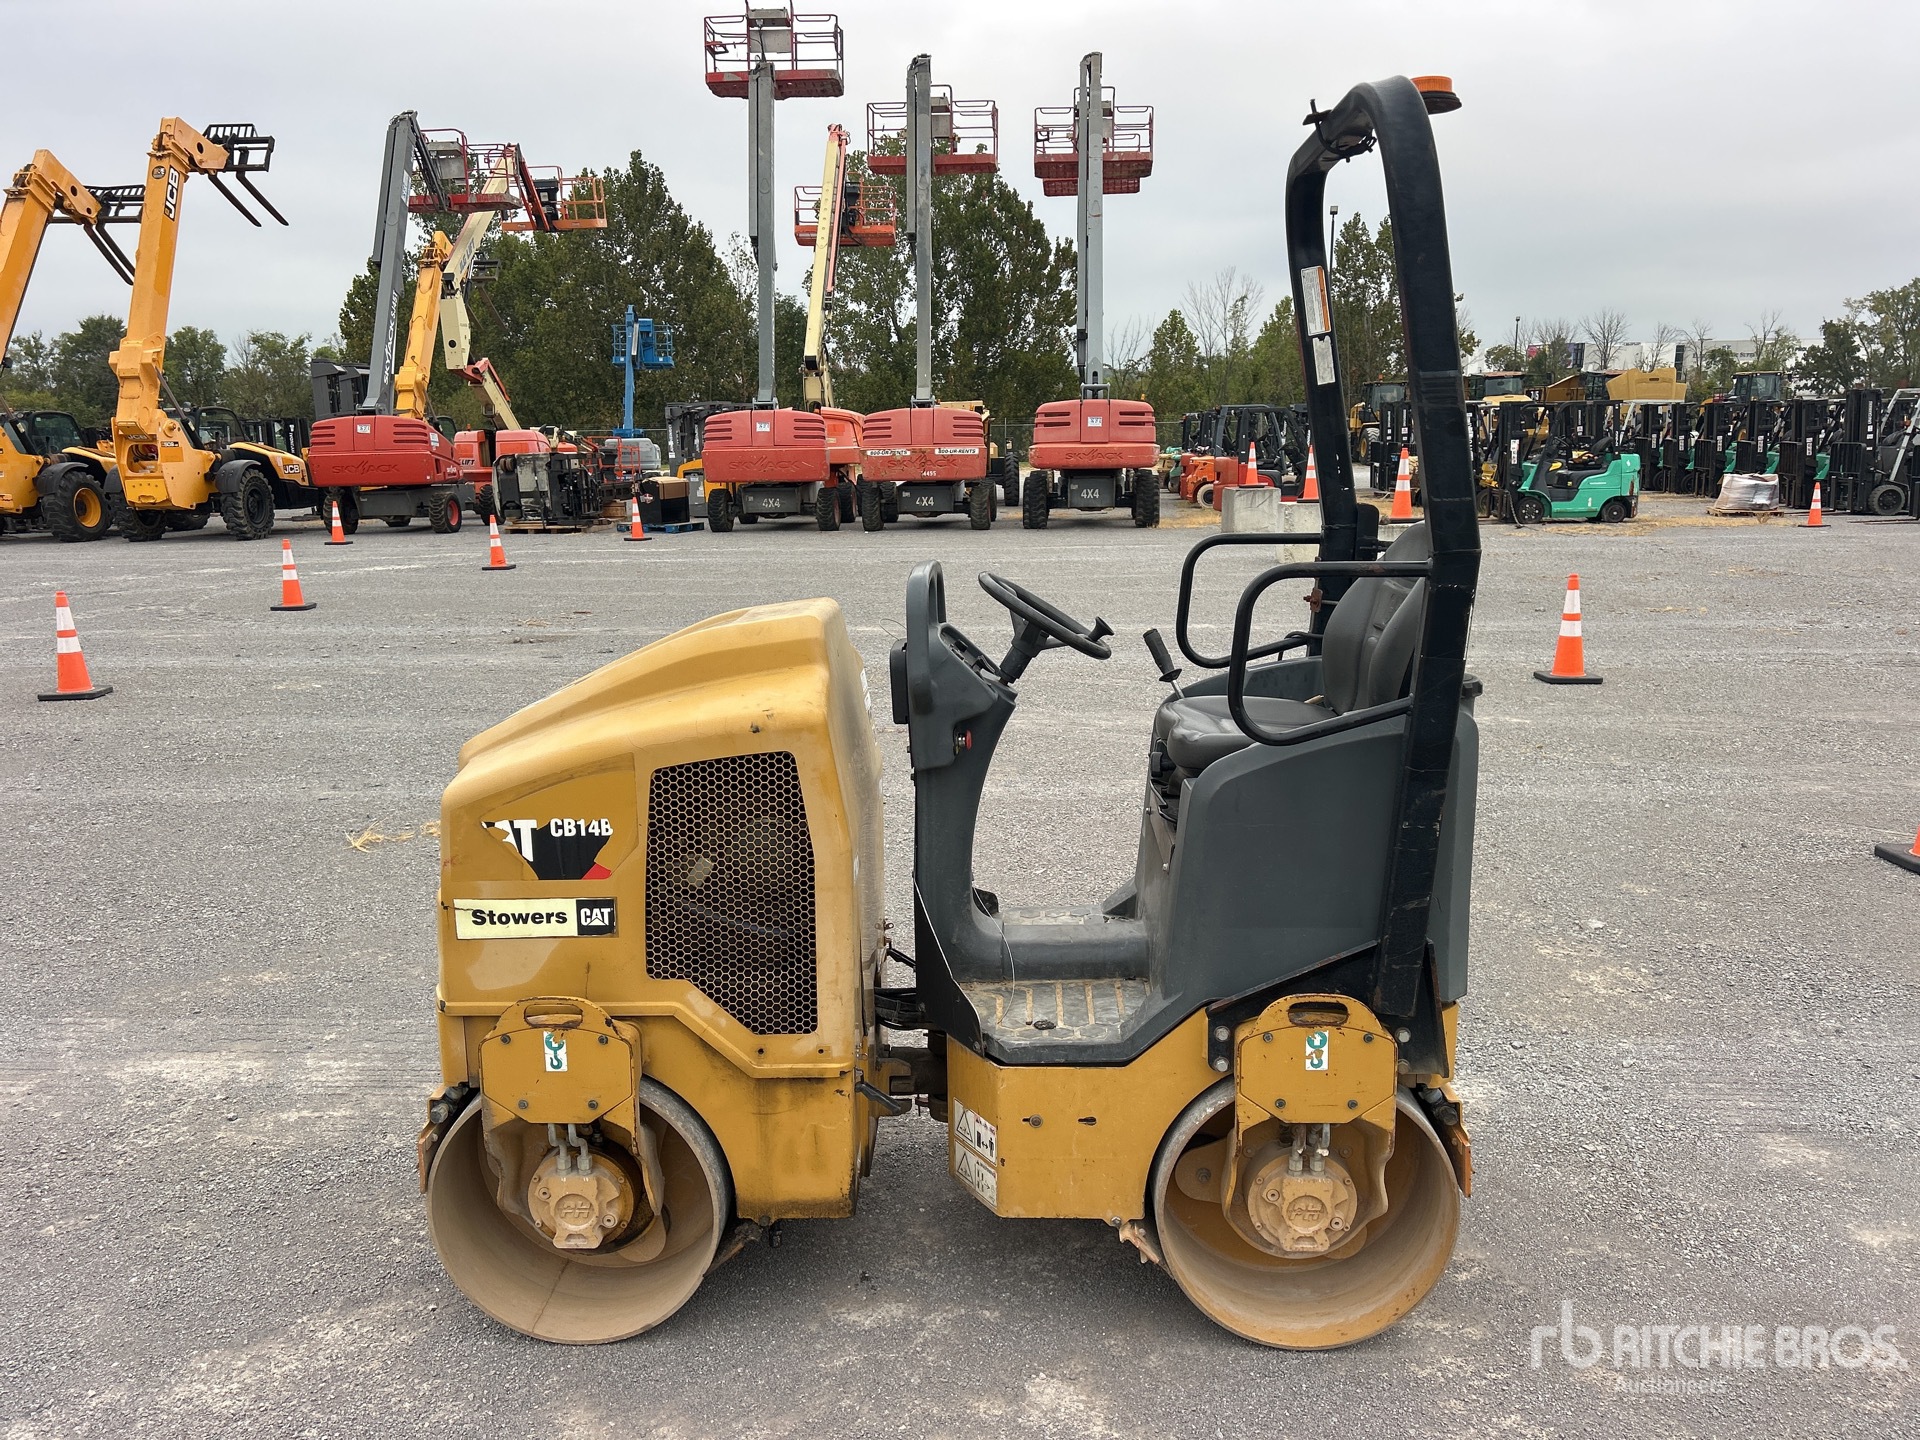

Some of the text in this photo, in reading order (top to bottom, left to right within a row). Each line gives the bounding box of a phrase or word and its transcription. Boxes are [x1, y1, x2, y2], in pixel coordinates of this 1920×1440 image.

[164, 169, 180, 219] JCB
[384, 319, 395, 385] SKYJACK
[887, 454, 957, 469] SKYJACK
[1065, 449, 1124, 461] SKYJACK
[284, 464, 300, 473] JCB
[332, 460, 399, 475] SKYJACK
[729, 455, 800, 472] SKYJACK
[1081, 488, 1100, 499] 4X4
[762, 498, 780, 508] 4X4
[916, 496, 934, 507] 4X4
[550, 818, 614, 837] CB14B
[472, 907, 613, 926] Stowers CAT
